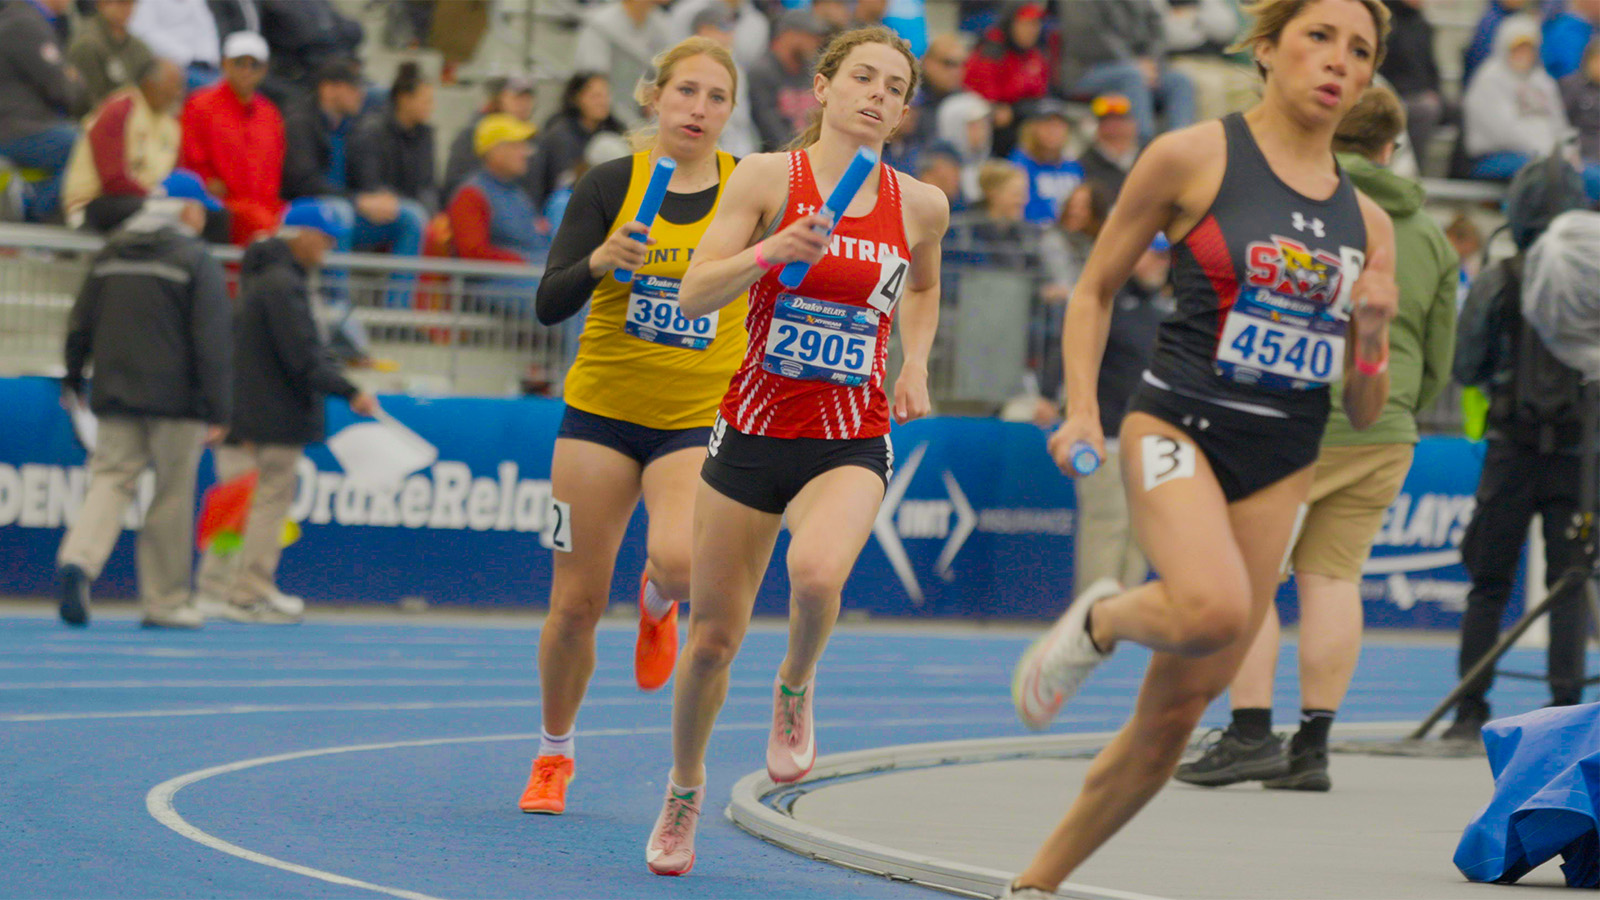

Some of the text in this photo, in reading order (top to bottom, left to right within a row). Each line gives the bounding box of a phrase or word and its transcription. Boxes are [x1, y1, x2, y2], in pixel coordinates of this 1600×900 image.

[791, 297, 823, 313] Drake
[822, 306, 847, 317] RELAYS
[880, 262, 907, 311] 4
[773, 324, 867, 370] 2905
[1231, 324, 1333, 378] 4540
[1156, 435, 1180, 479] 3
[553, 503, 565, 548] 2
